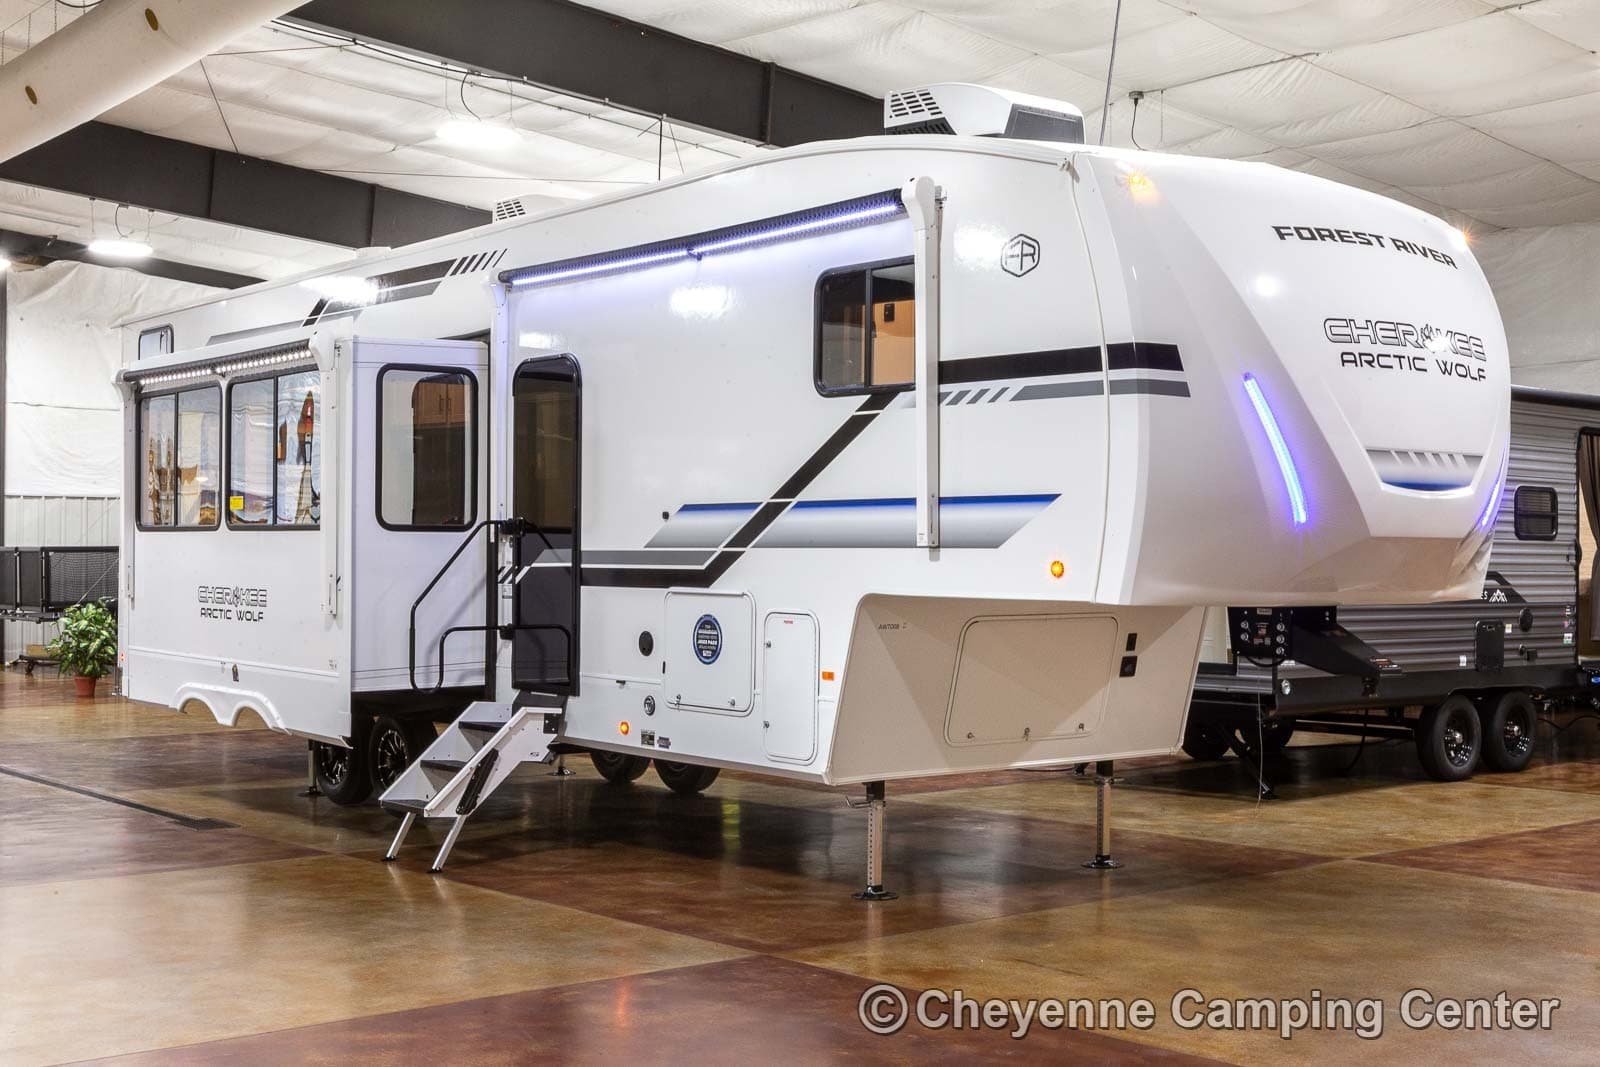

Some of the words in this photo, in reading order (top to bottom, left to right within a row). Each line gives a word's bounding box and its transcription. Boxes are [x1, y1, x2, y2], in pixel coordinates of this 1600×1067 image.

[1272, 226, 1386, 249] FOREST
[1389, 237, 1459, 269] RIVER
[1340, 351, 1428, 372] ARCTIC
[1435, 359, 1487, 382] WOLF
[200, 607, 232, 620] ARCTIC
[236, 609, 264, 622] WOLF
